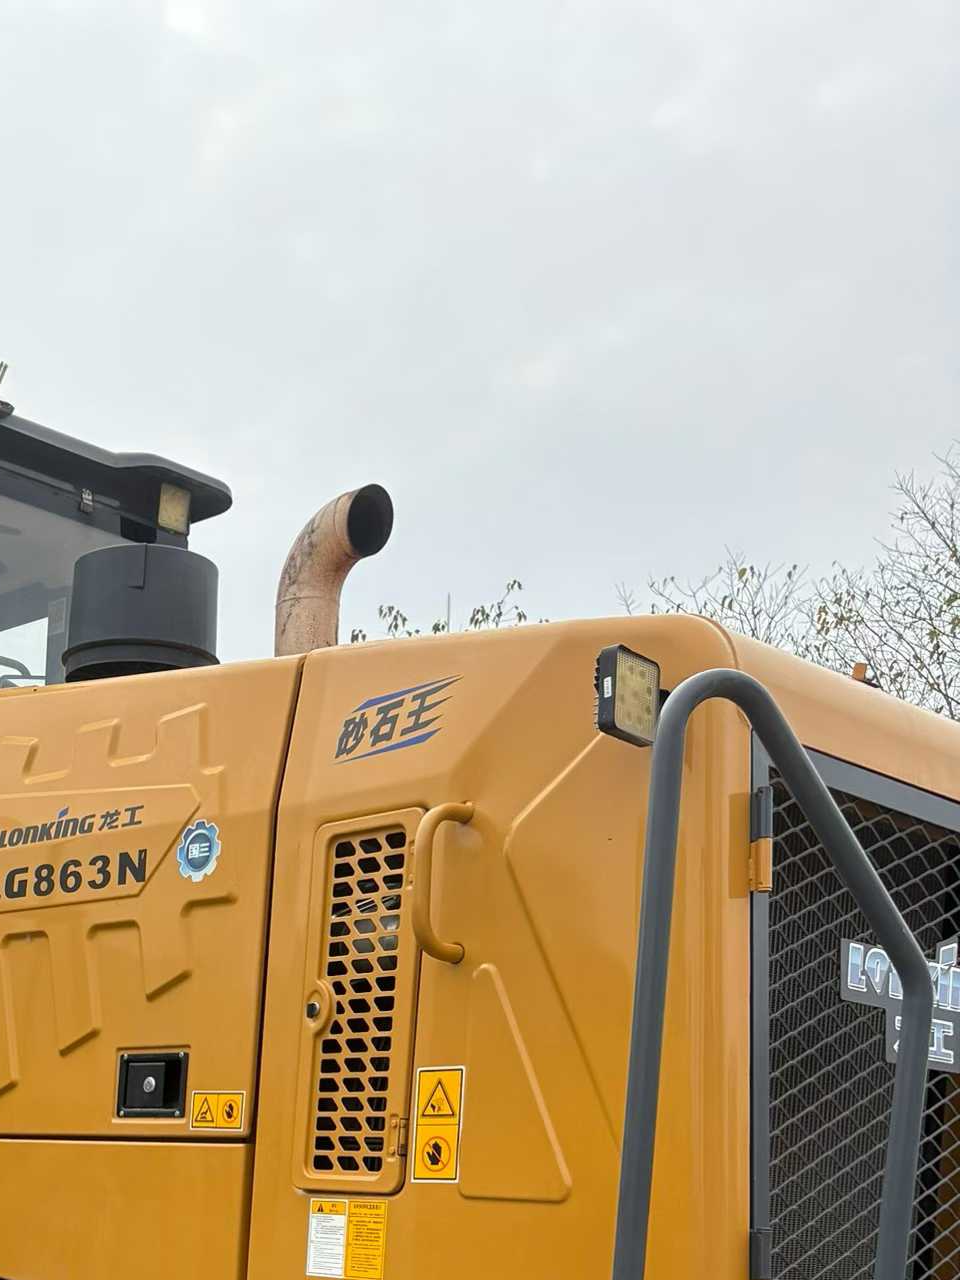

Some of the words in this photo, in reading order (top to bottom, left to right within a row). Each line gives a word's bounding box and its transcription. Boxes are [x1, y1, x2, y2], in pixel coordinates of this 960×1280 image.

[334, 676, 464, 759] 砂石王
[98, 805, 145, 832] 龙工
